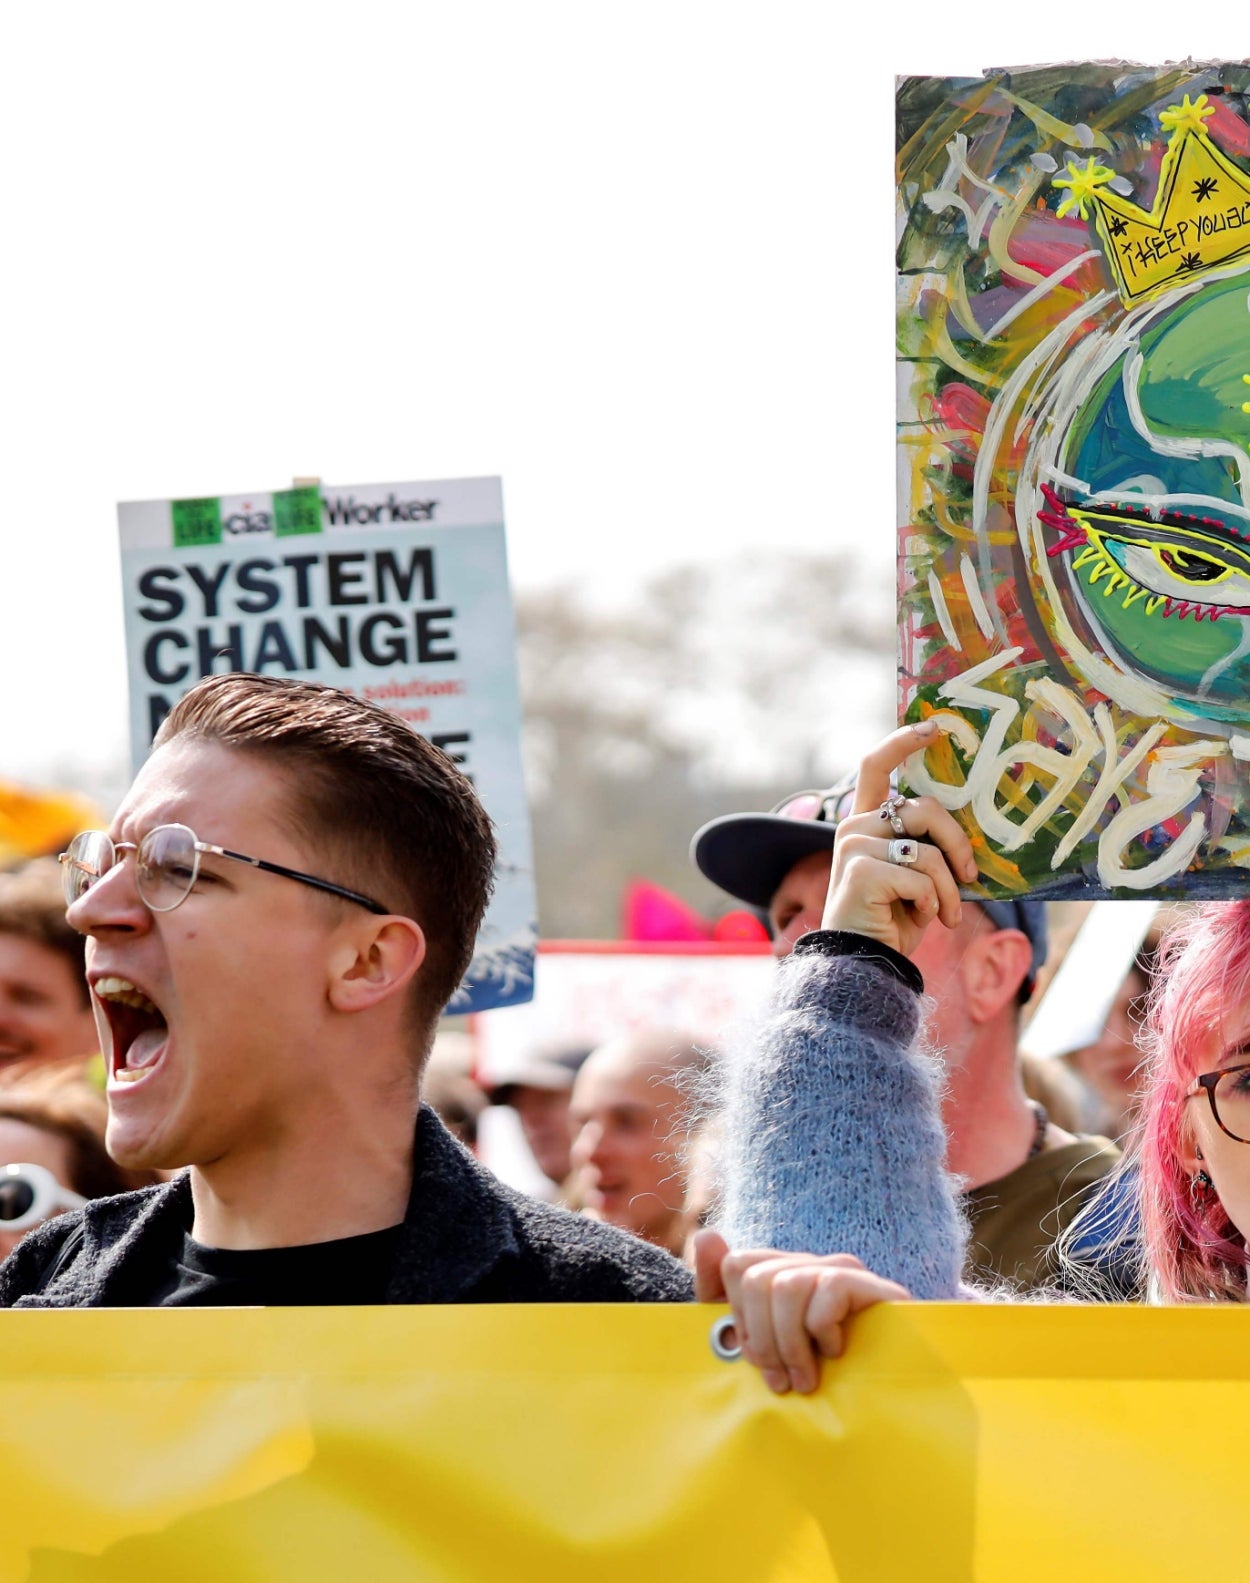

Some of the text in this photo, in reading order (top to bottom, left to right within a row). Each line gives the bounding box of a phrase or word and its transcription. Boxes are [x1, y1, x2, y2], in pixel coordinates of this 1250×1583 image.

[323, 491, 439, 527] Worker
[137, 546, 437, 623] SYSTEM
[143, 608, 459, 685] CHANGE
